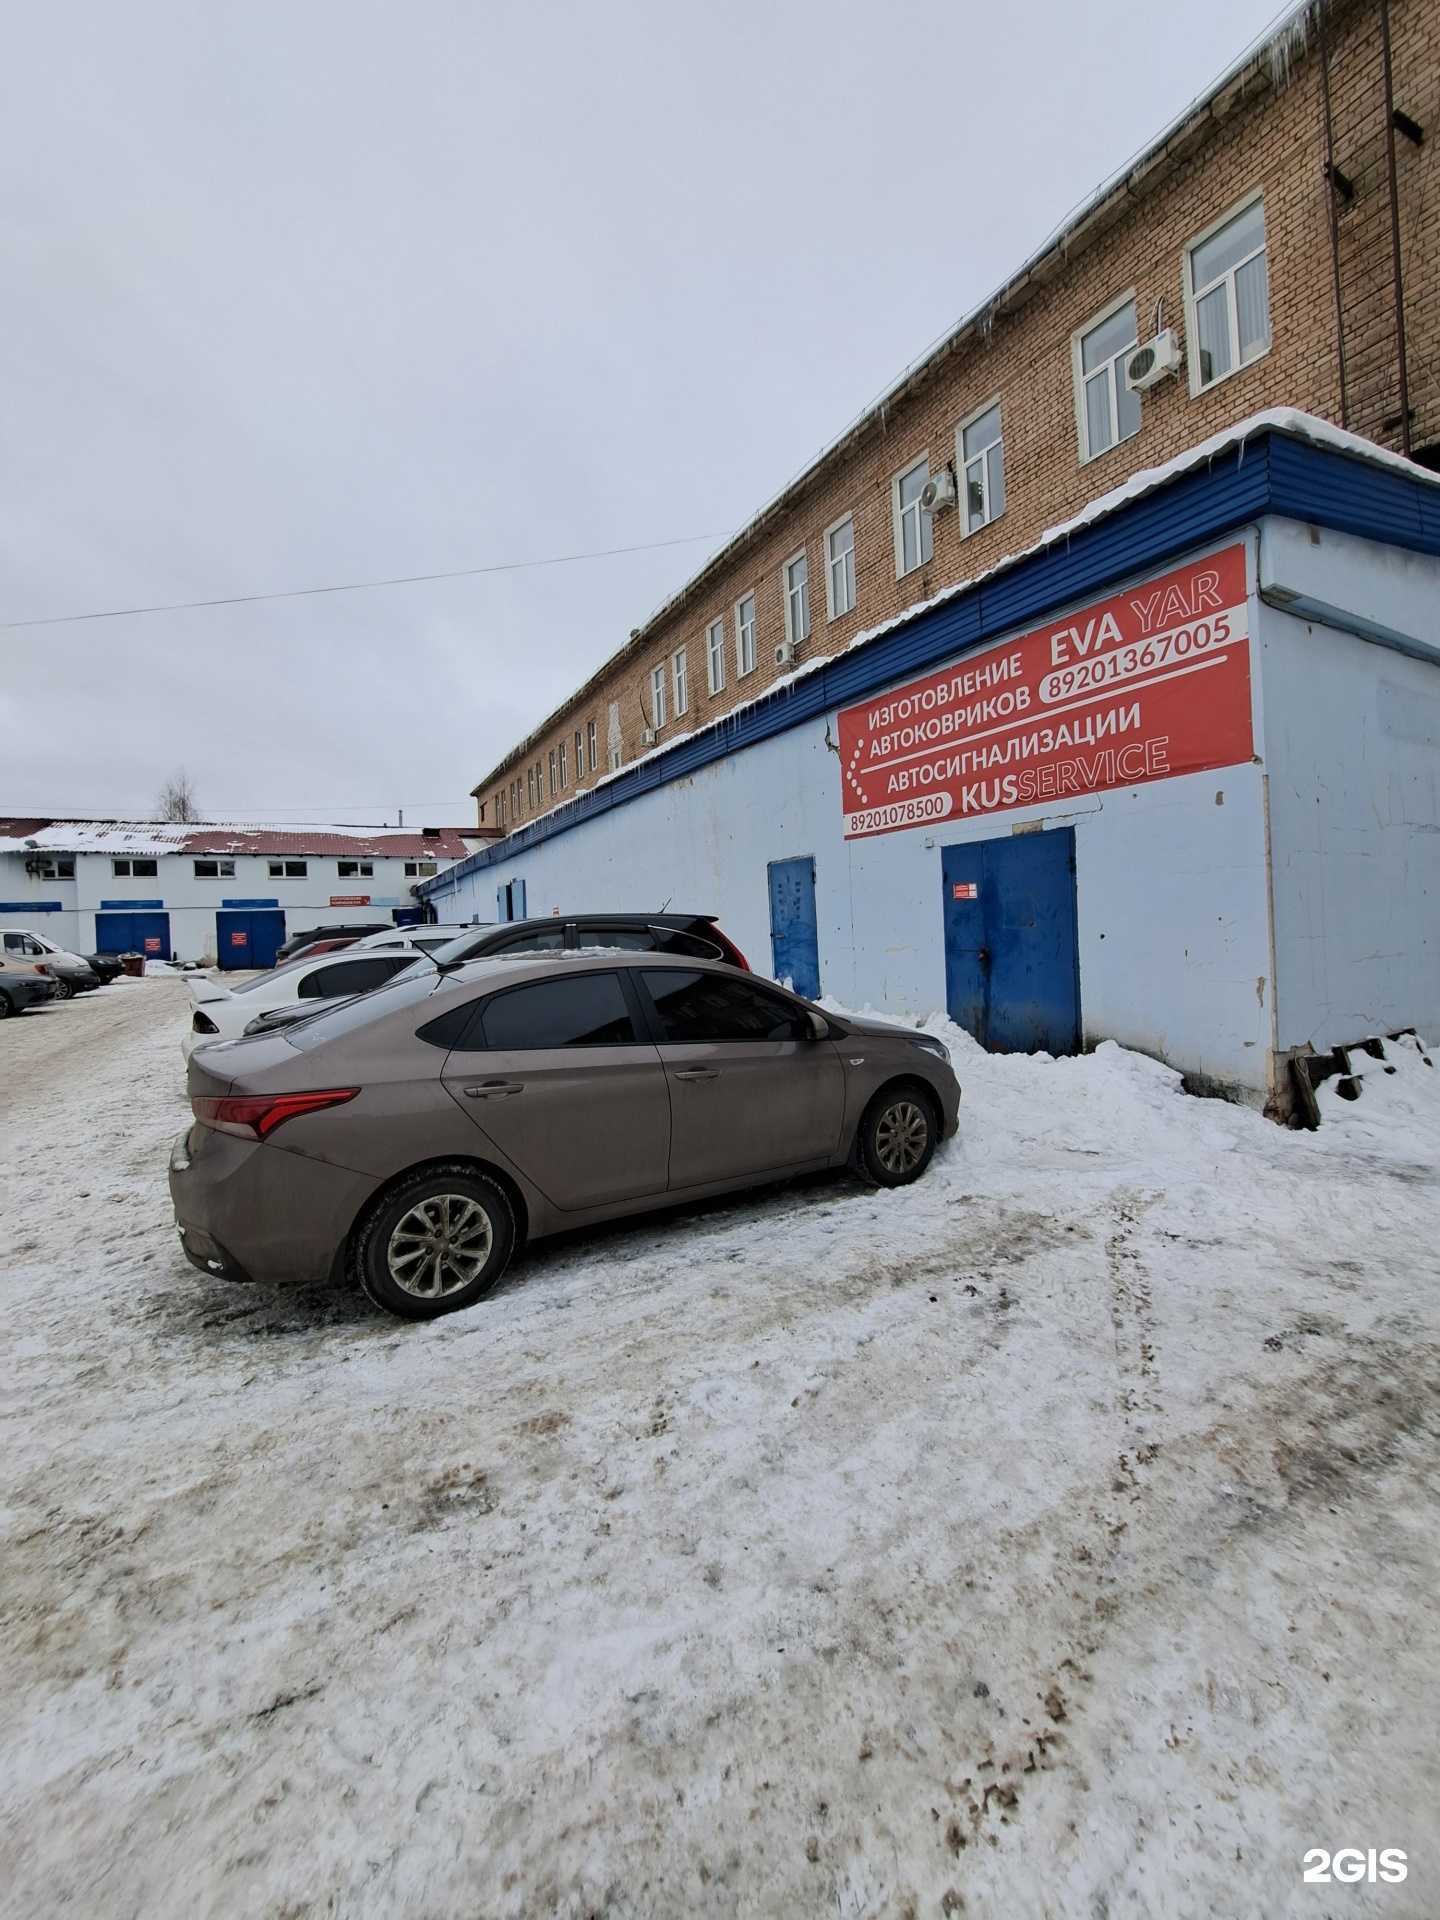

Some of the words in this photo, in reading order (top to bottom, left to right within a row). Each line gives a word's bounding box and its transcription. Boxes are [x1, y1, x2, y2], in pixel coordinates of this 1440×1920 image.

[1048, 615, 1231, 699] 89201367005
[1050, 612, 1123, 666] EVA
[1130, 570, 1223, 633] YAR
[867, 652, 1024, 731] ИЗГОТОВЛЕНИЕ
[869, 686, 1031, 758] АВТОКОВРИКОВ
[887, 702, 1142, 794] АВТОСИГНАЛИЗАЦИИ
[961, 736, 1171, 813] KUSSERVICE
[850, 796, 945, 832] 89201078500
